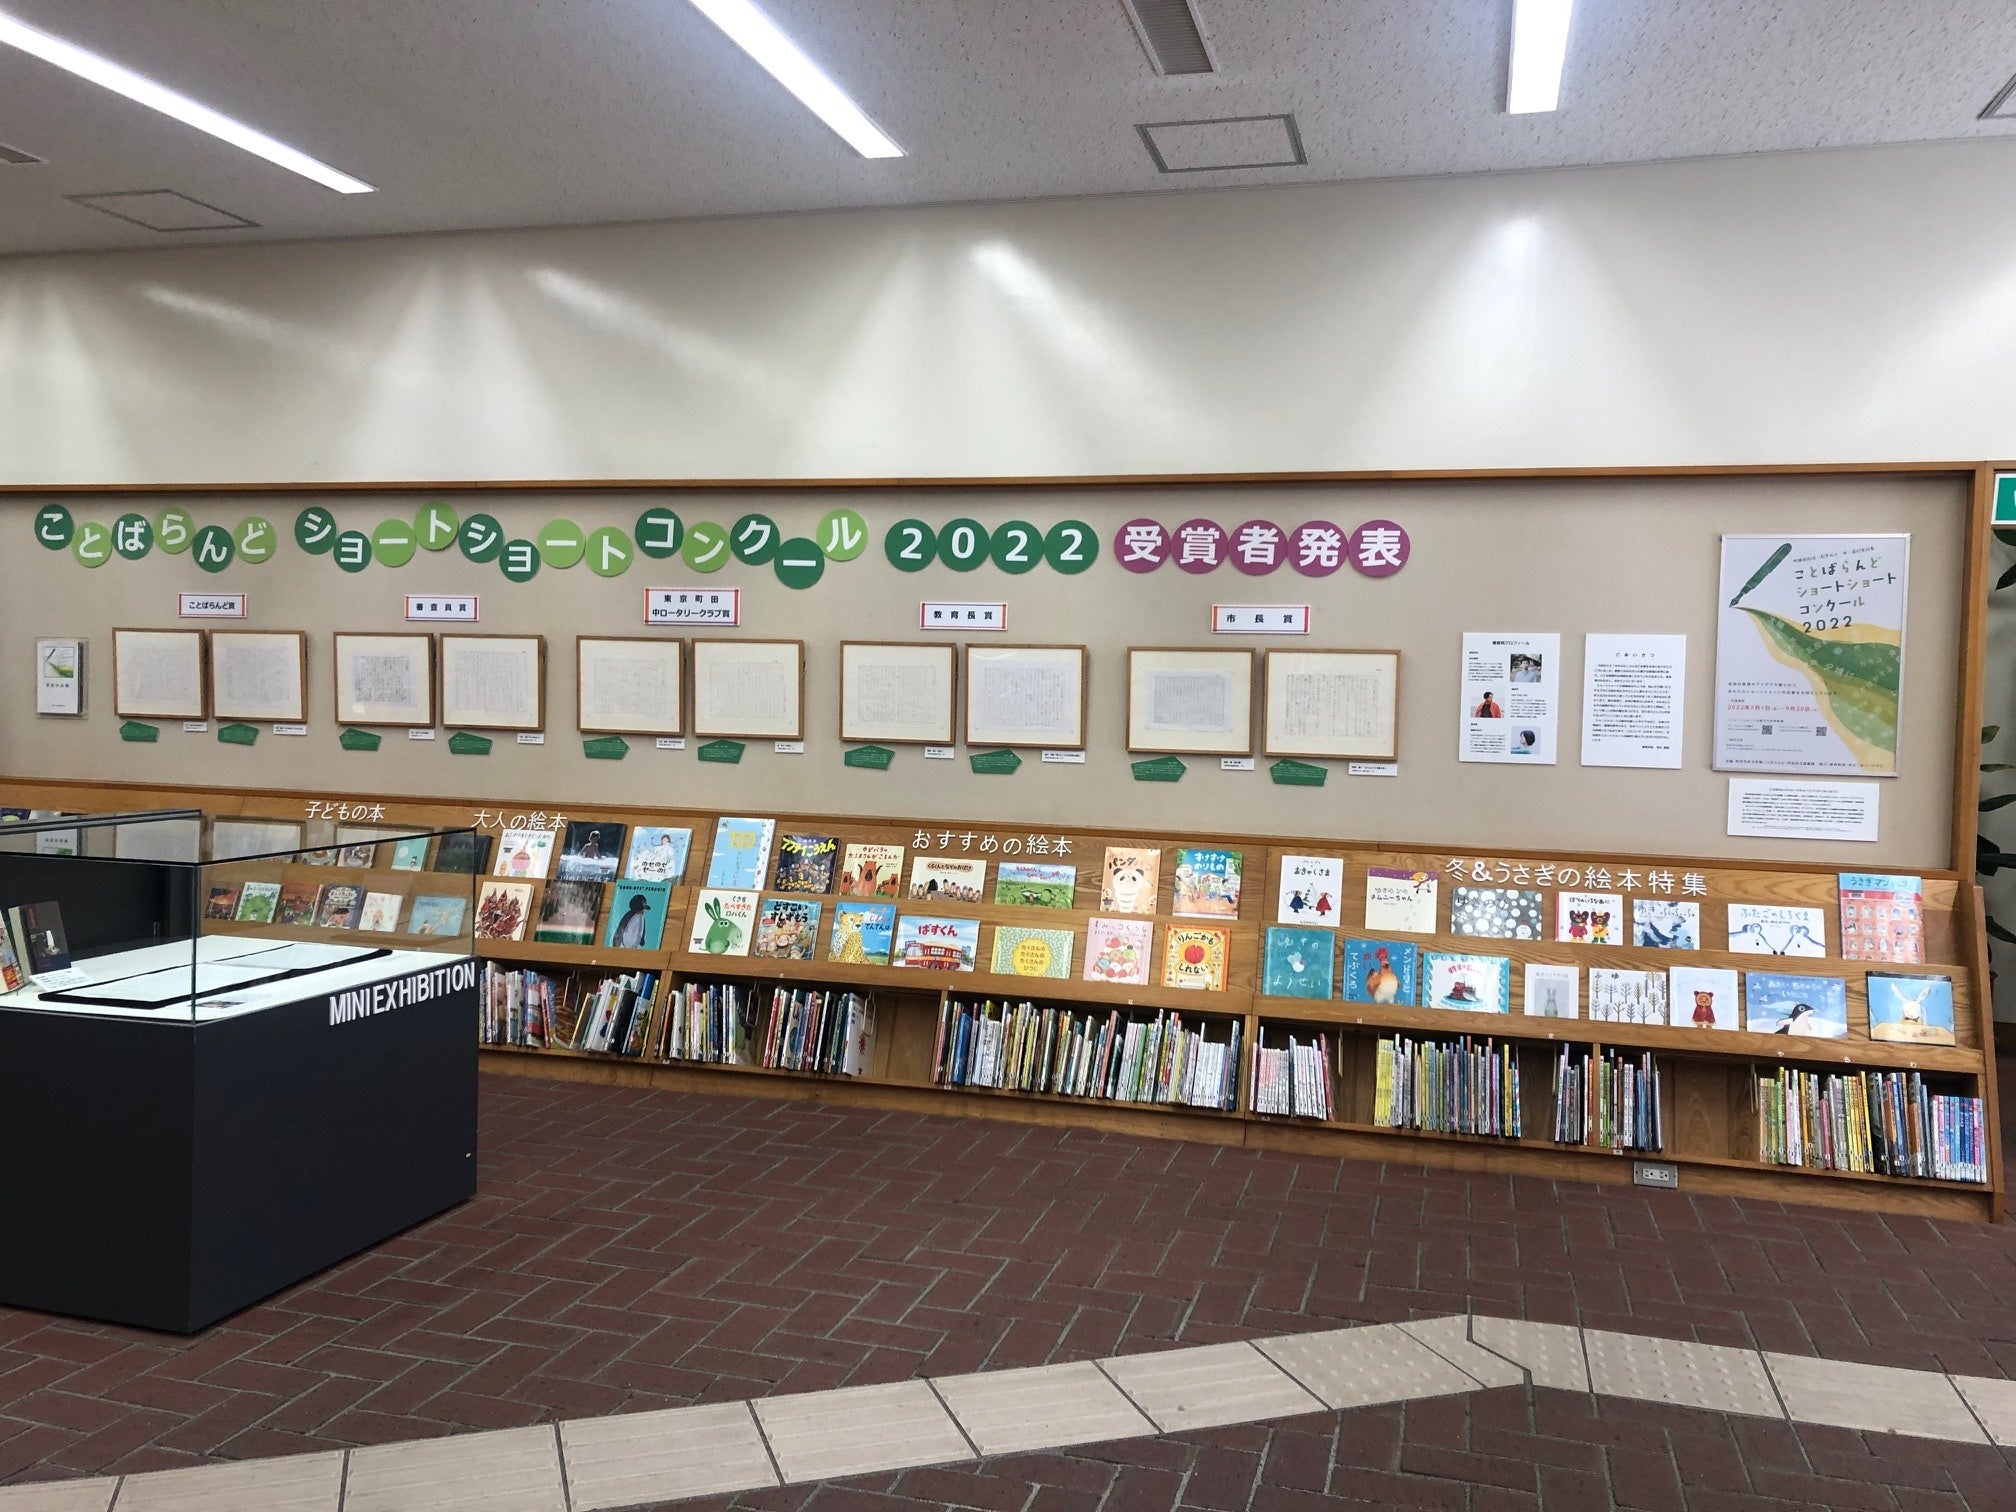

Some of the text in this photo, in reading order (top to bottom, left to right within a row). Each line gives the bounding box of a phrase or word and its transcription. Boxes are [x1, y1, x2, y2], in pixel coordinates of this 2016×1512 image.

[40, 511, 268, 563] ことばらんど
[900, 528, 1084, 562] 2022
[1124, 525, 1403, 567] 受賞者発表
[1794, 556, 1882, 580] ことばらんど
[1796, 572, 1897, 598] ショートショート
[188, 601, 236, 610] ことばらんど賞
[415, 602, 468, 612] 審査員賞
[663, 594, 720, 604] 東京町田
[1799, 596, 1866, 615] コンクール
[652, 608, 730, 618] 中ロータリークラブ賞
[933, 609, 994, 621] 教育長賞
[1226, 613, 1294, 624] 市長賞
[1803, 615, 1853, 634] 2022
[304, 801, 386, 822] 子どもの本
[470, 809, 568, 832] 大人の絵本
[912, 829, 1073, 858] おすすめの絵本
[1444, 857, 1708, 897] 冬&うさぎの絵本特集
[773, 901, 809, 911] どすこい
[917, 924, 959, 937] ばすくん
[329, 962, 476, 1026] MINI EXHIBITION
